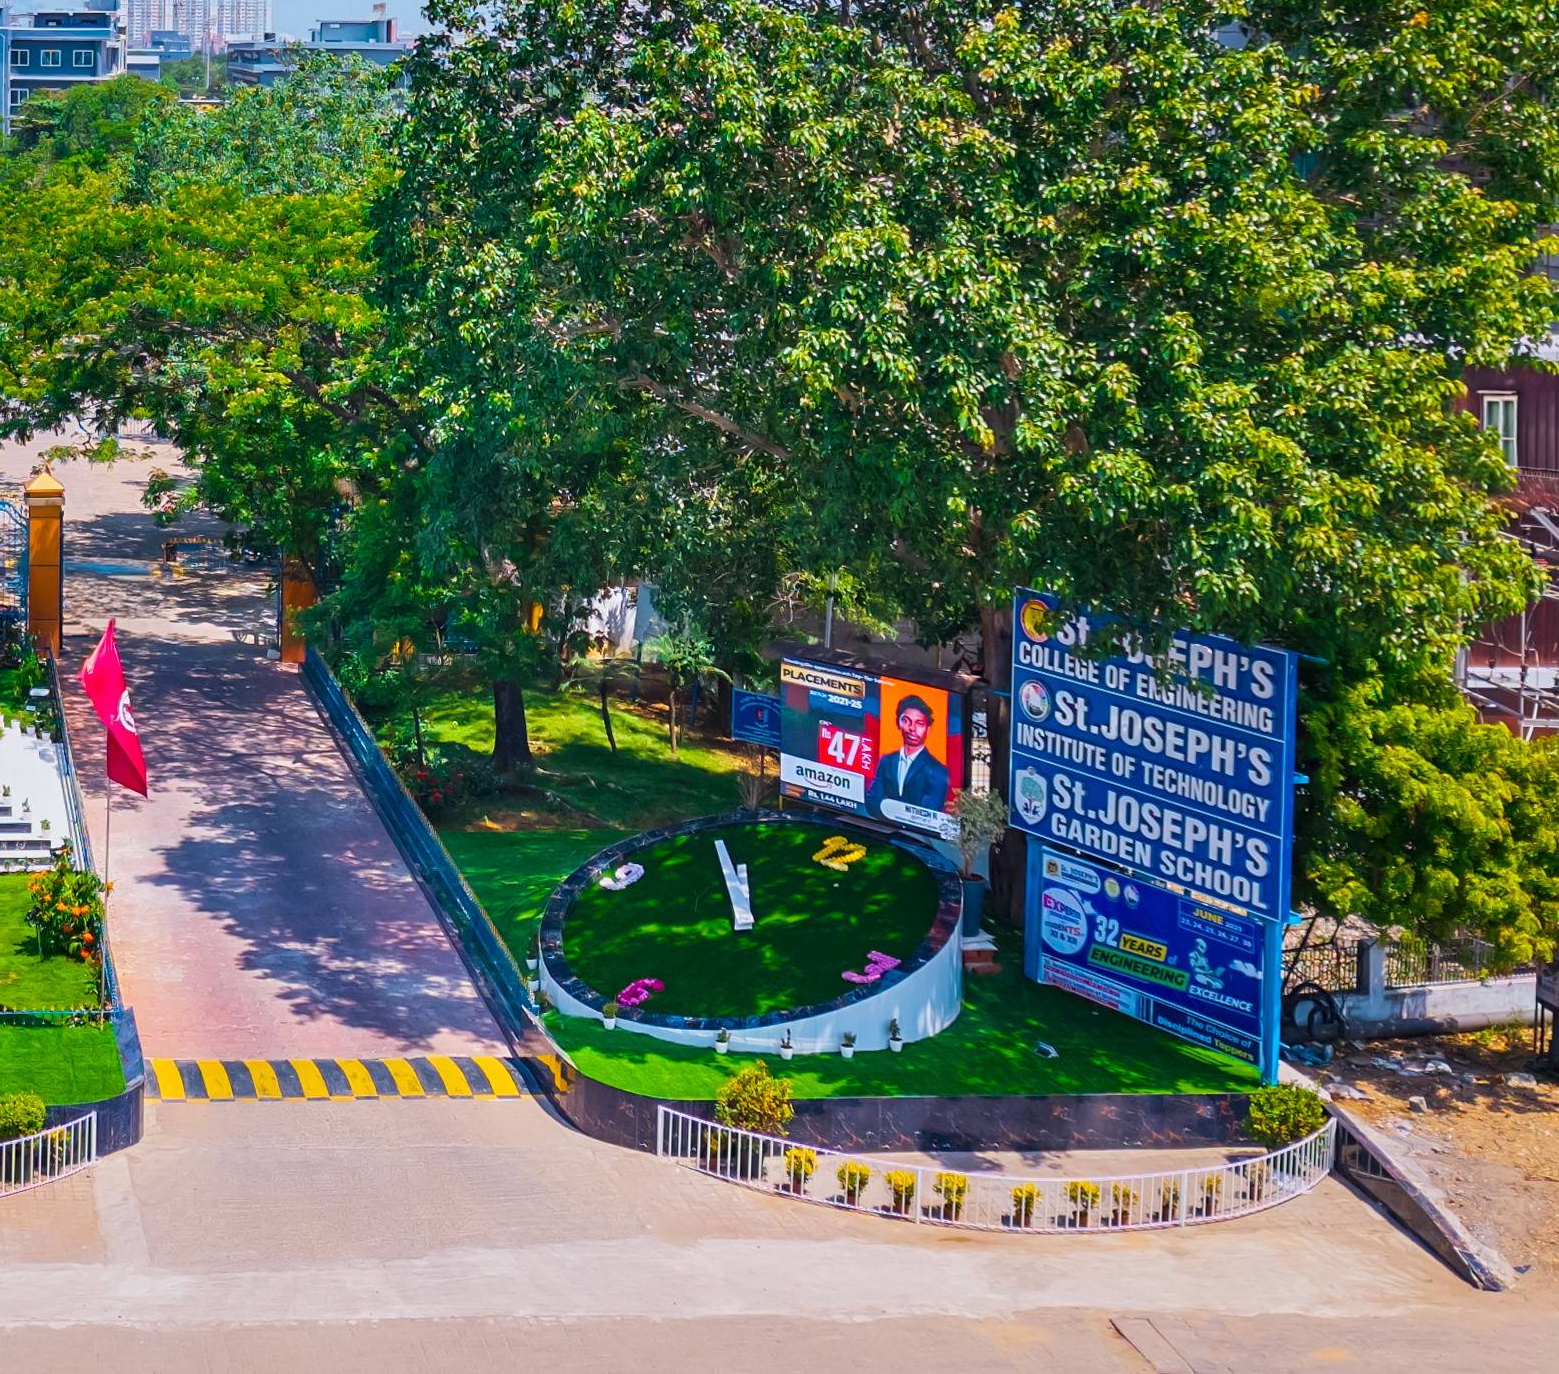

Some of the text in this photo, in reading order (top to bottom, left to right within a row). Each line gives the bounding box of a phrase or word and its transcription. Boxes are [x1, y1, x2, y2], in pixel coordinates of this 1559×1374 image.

[782, 668, 861, 695] PLACEMENTS
[1019, 641, 1274, 734] COLLEGE OF ENGINEERING
[827, 693, 863, 709] 2021-25
[827, 730, 861, 767] 47
[861, 736, 873, 771] LAKH
[795, 765, 850, 790] amazon
[1017, 722, 1271, 823] INSTITUTE OF TECHNOLOGY
[1051, 812, 1269, 910] GARDEN SCHOOL
[1193, 908, 1224, 925] JUNE
[1093, 915, 1120, 947] 32
[1122, 936, 1163, 958] YEARS
[1090, 948, 1186, 986] ENGINEERING
[1188, 985, 1254, 1012] EXCELLENCE
[1186, 1015, 1253, 1048] The Choice of
